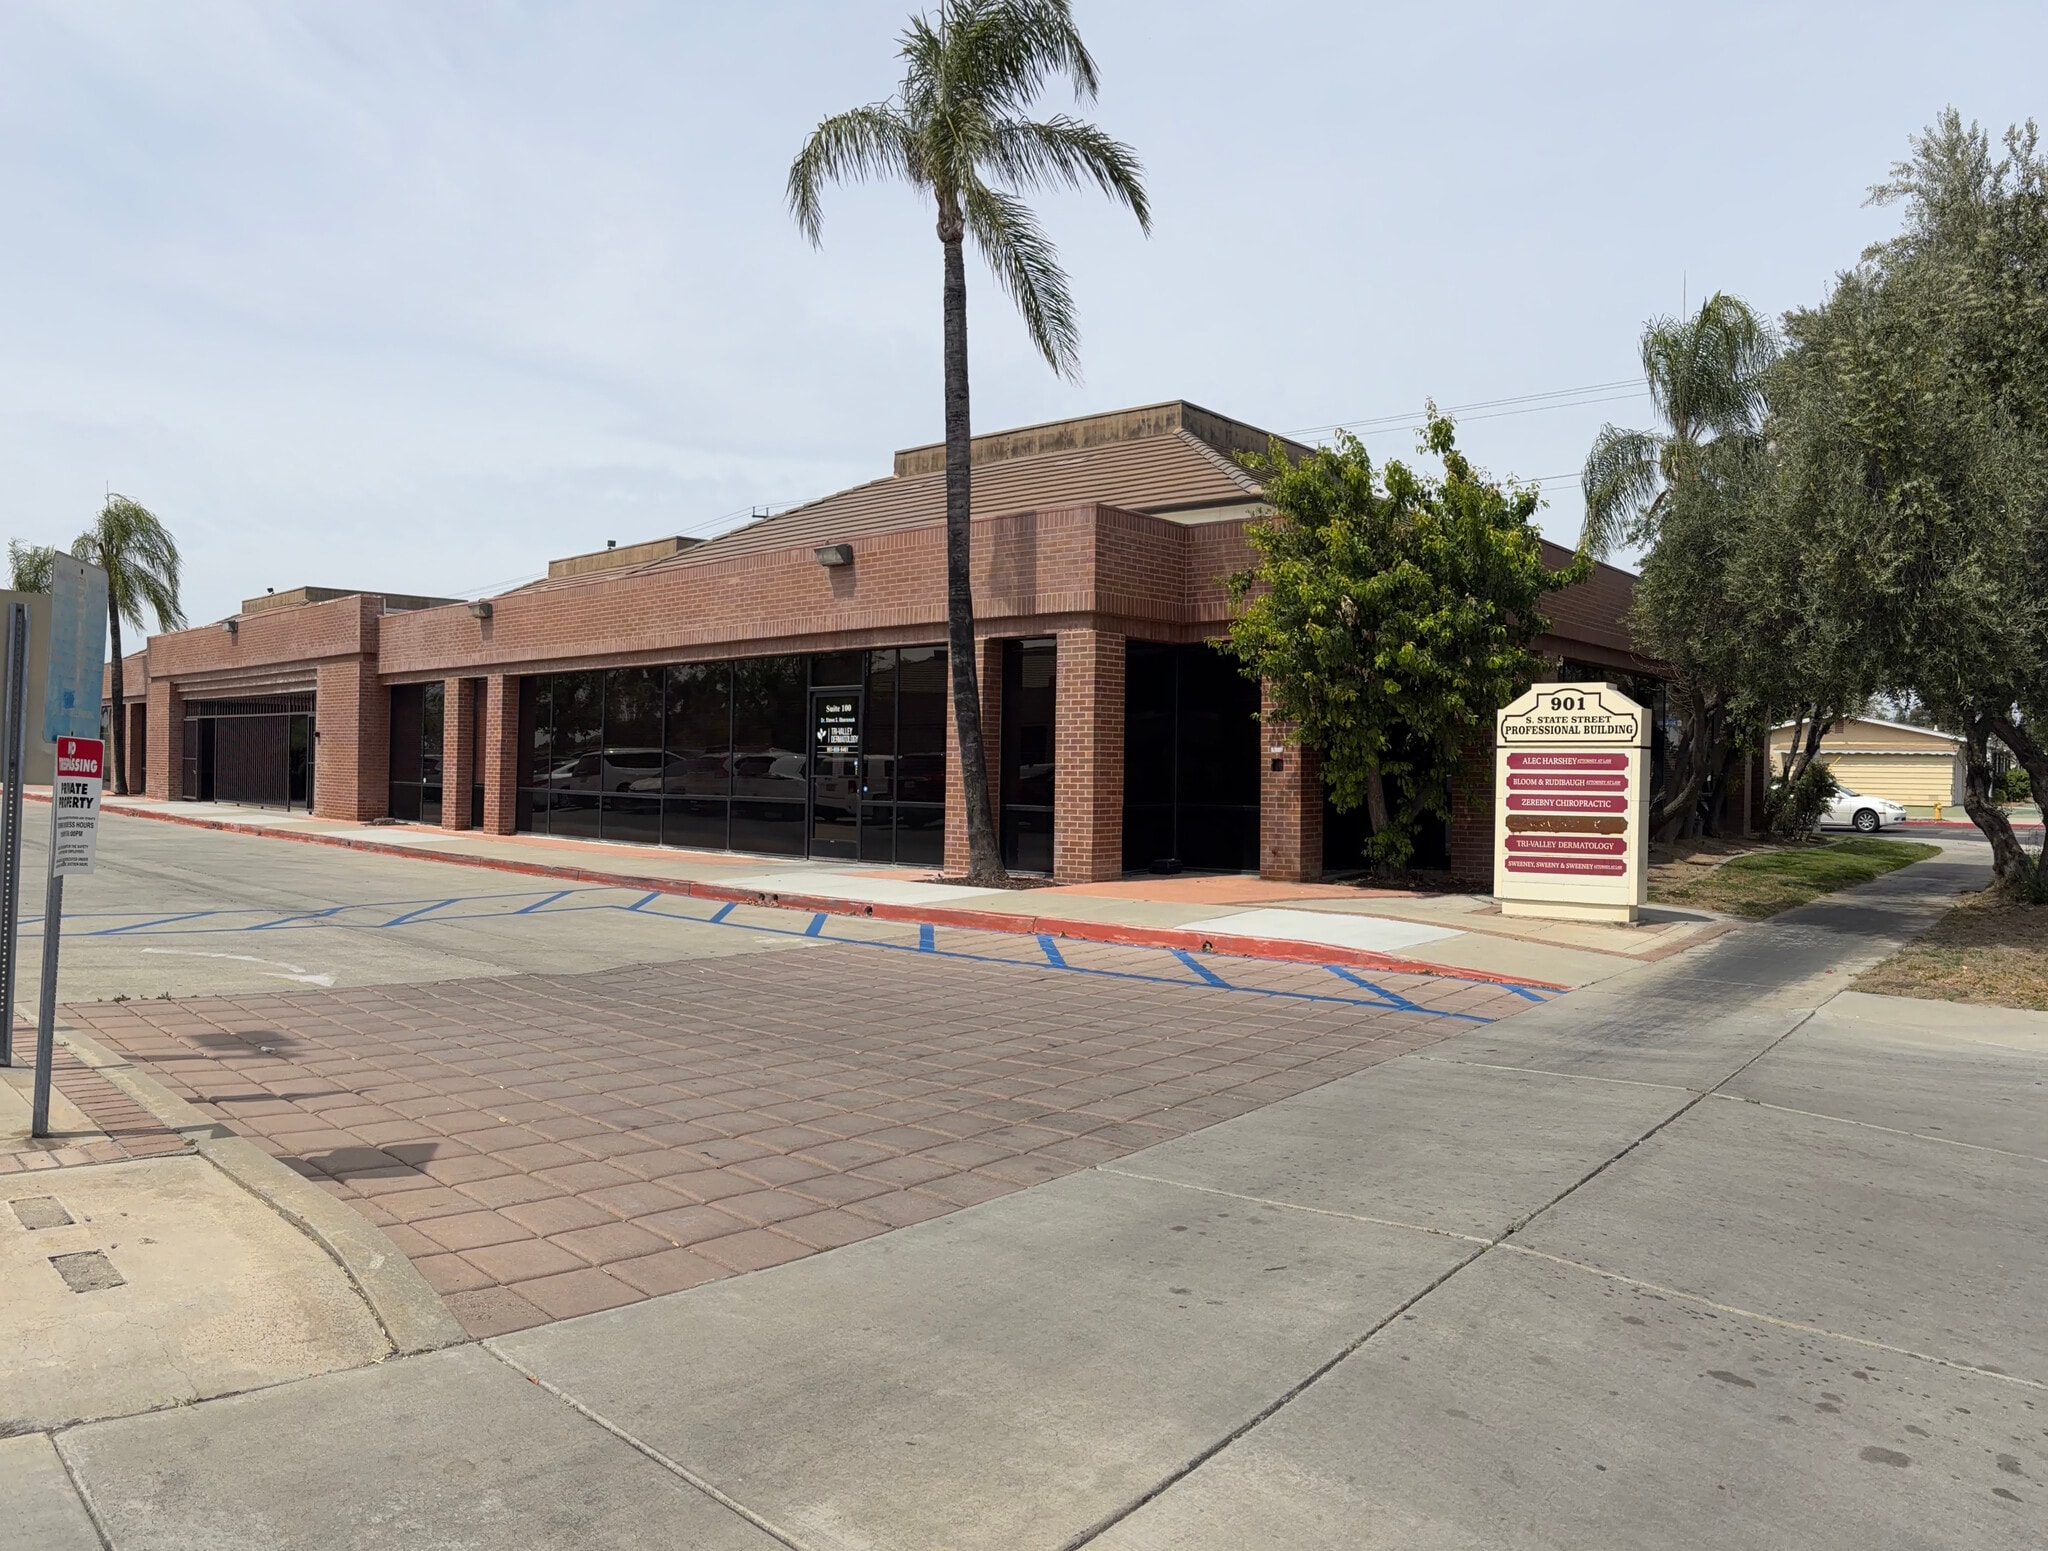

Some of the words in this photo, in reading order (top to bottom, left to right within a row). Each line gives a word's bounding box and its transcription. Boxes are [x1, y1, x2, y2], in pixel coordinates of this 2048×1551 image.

[842, 704, 851, 712] 100
[1551, 697, 1586, 710] 901
[1526, 716, 1534, 724] S.
[1505, 726, 1580, 735] PROFESSIONAL
[1584, 725, 1633, 734] BUILDING
[59, 797, 94, 808] PROPERTY
[1516, 840, 1556, 848] TRI-VALLEY
[1558, 842, 1614, 850] DERMATOLOGY
